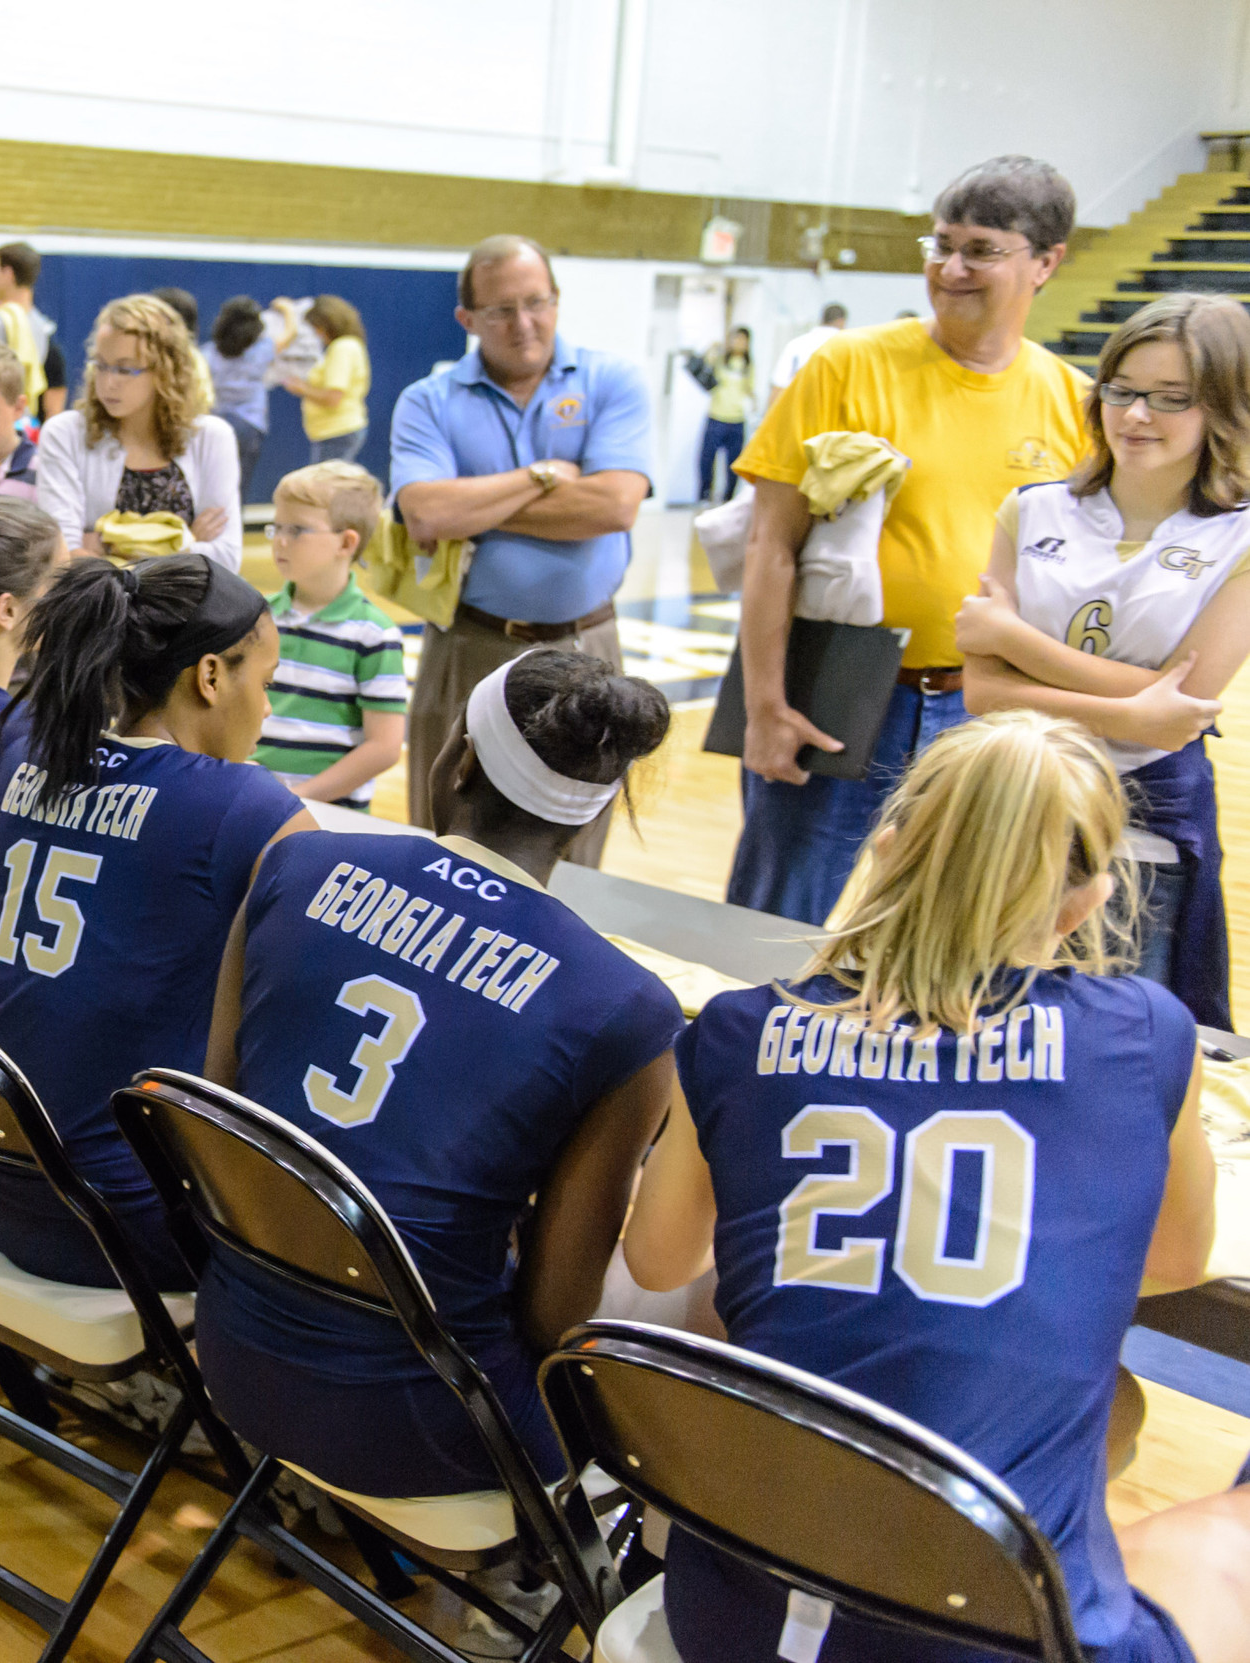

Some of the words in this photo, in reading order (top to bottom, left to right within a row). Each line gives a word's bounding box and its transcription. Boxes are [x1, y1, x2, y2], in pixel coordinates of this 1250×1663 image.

[1065, 599, 1114, 655] 6
[83, 783, 159, 841] TECH
[422, 857, 508, 901] ACC
[305, 862, 466, 973] GEORGIA
[446, 926, 561, 1014] TECH
[302, 973, 427, 1129] 3
[757, 1005, 943, 1082] GEORGIA
[773, 1103, 1037, 1308] 20
